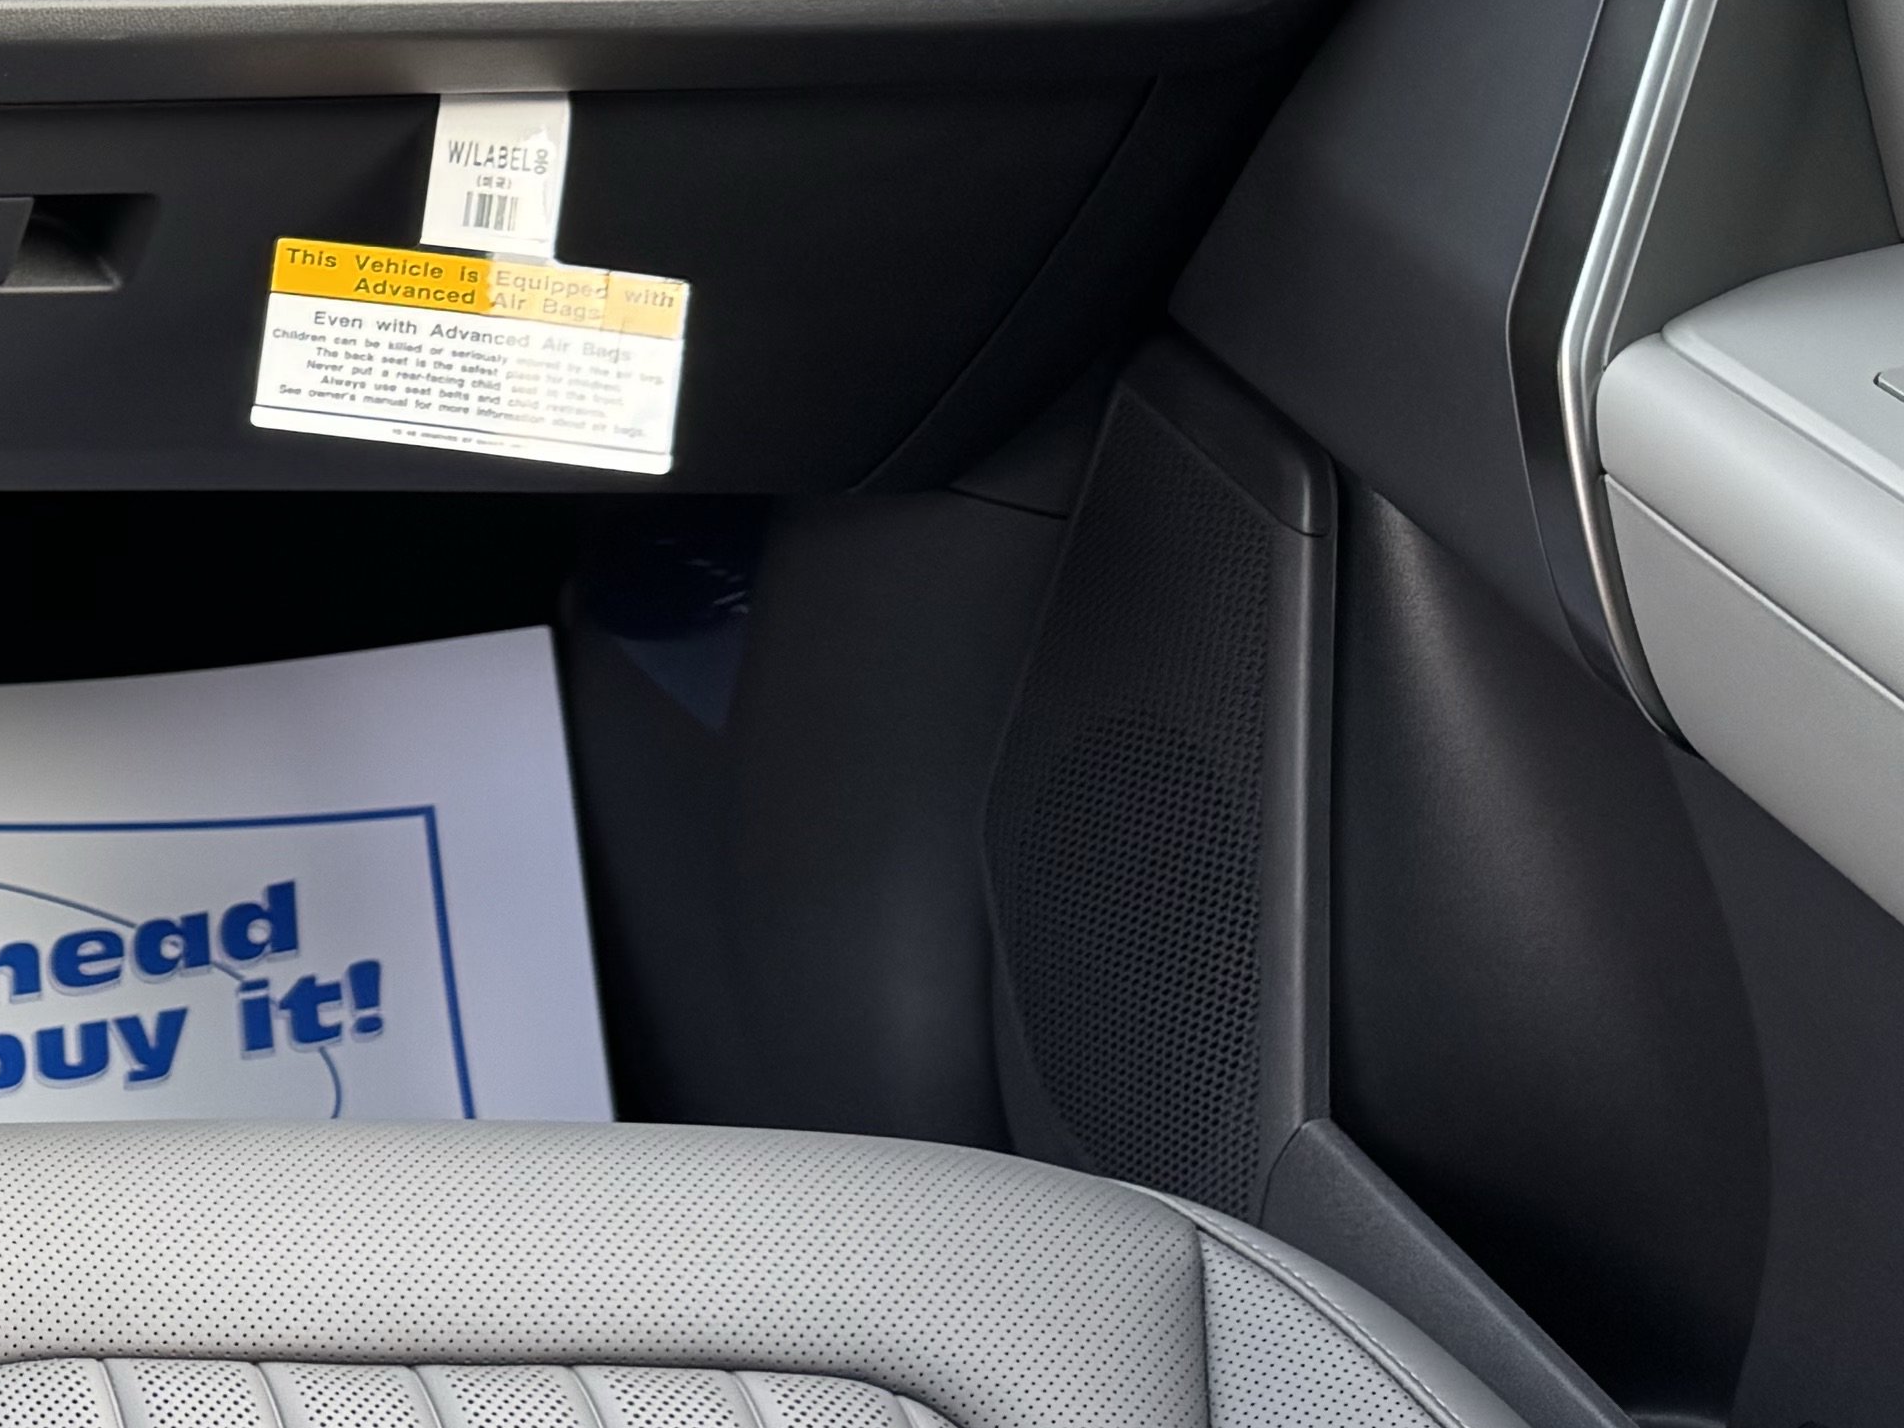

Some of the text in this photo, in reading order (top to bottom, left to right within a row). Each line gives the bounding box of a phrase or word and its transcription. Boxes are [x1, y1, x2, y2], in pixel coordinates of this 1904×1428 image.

[286, 247, 674, 308] This Vehicle is Equipped with
[354, 277, 601, 323] Advanced Air Bags
[272, 328, 327, 342] Children
[333, 335, 357, 346] can
[364, 338, 381, 349] be
[388, 342, 422, 353] killed
[429, 347, 443, 355] or
[451, 349, 508, 365] seriously
[314, 311, 632, 364] Even with Advanced Air Bags
[306, 359, 344, 372] Never
[351, 365, 373, 376] put
[381, 369, 389, 377] a
[396, 371, 465, 388] rear-facing
[470, 379, 501, 391] child
[316, 346, 338, 358] The
[344, 350, 374, 362] back
[381, 355, 408, 366] seat
[415, 358, 426, 368] is
[433, 360, 453, 371] the
[460, 364, 498, 376] safest
[279, 384, 301, 395] See
[308, 388, 356, 402] owner's
[362, 395, 408, 407] manual
[415, 399, 432, 410] for
[438, 403, 470, 414] more
[321, 375, 366, 389] Always
[374, 382, 397, 392] use
[405, 385, 432, 396] seat
[438, 388, 470, 401] belts
[477, 393, 501, 405] and
[238, 958, 385, 1054] it!
